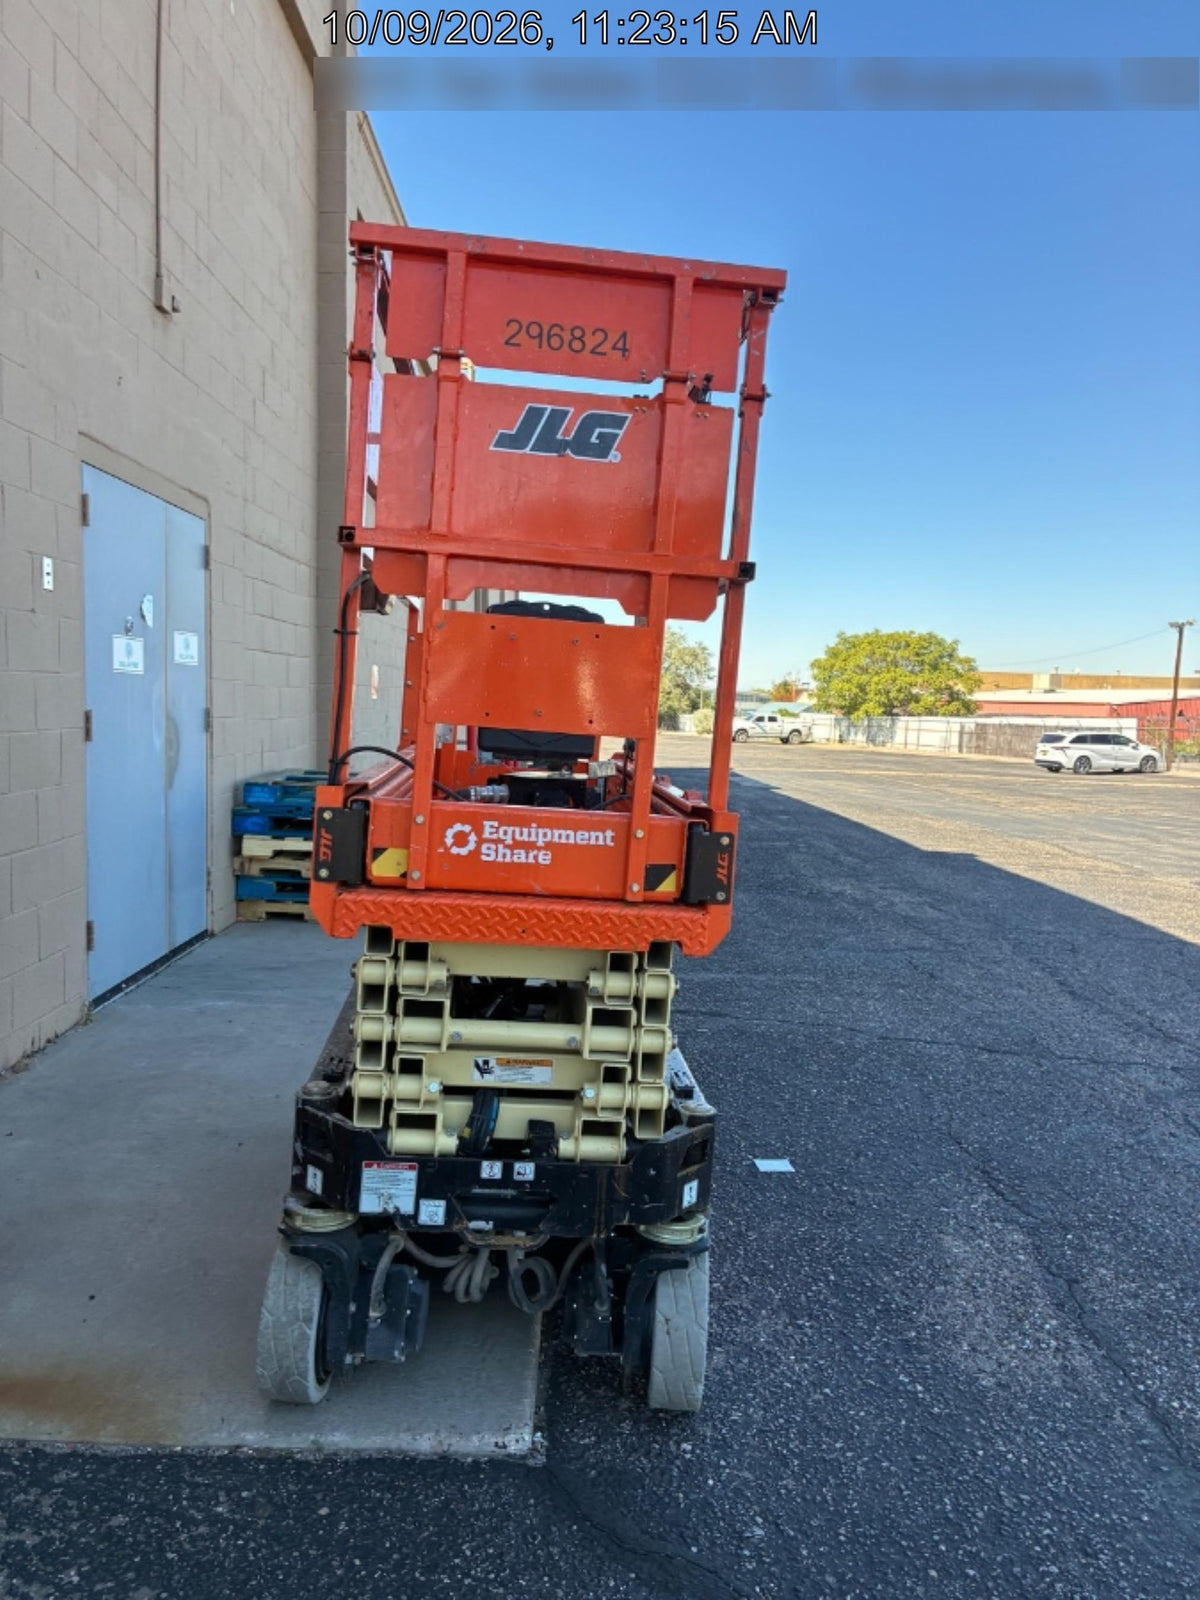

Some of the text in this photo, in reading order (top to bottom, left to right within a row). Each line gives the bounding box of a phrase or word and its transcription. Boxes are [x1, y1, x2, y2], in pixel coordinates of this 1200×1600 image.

[504, 319, 630, 358] 296824
[490, 403, 633, 462] JLG
[319, 827, 333, 863] JLG
[482, 820, 615, 847] Equipment
[480, 843, 552, 865] Share
[716, 852, 729, 885] JLG
